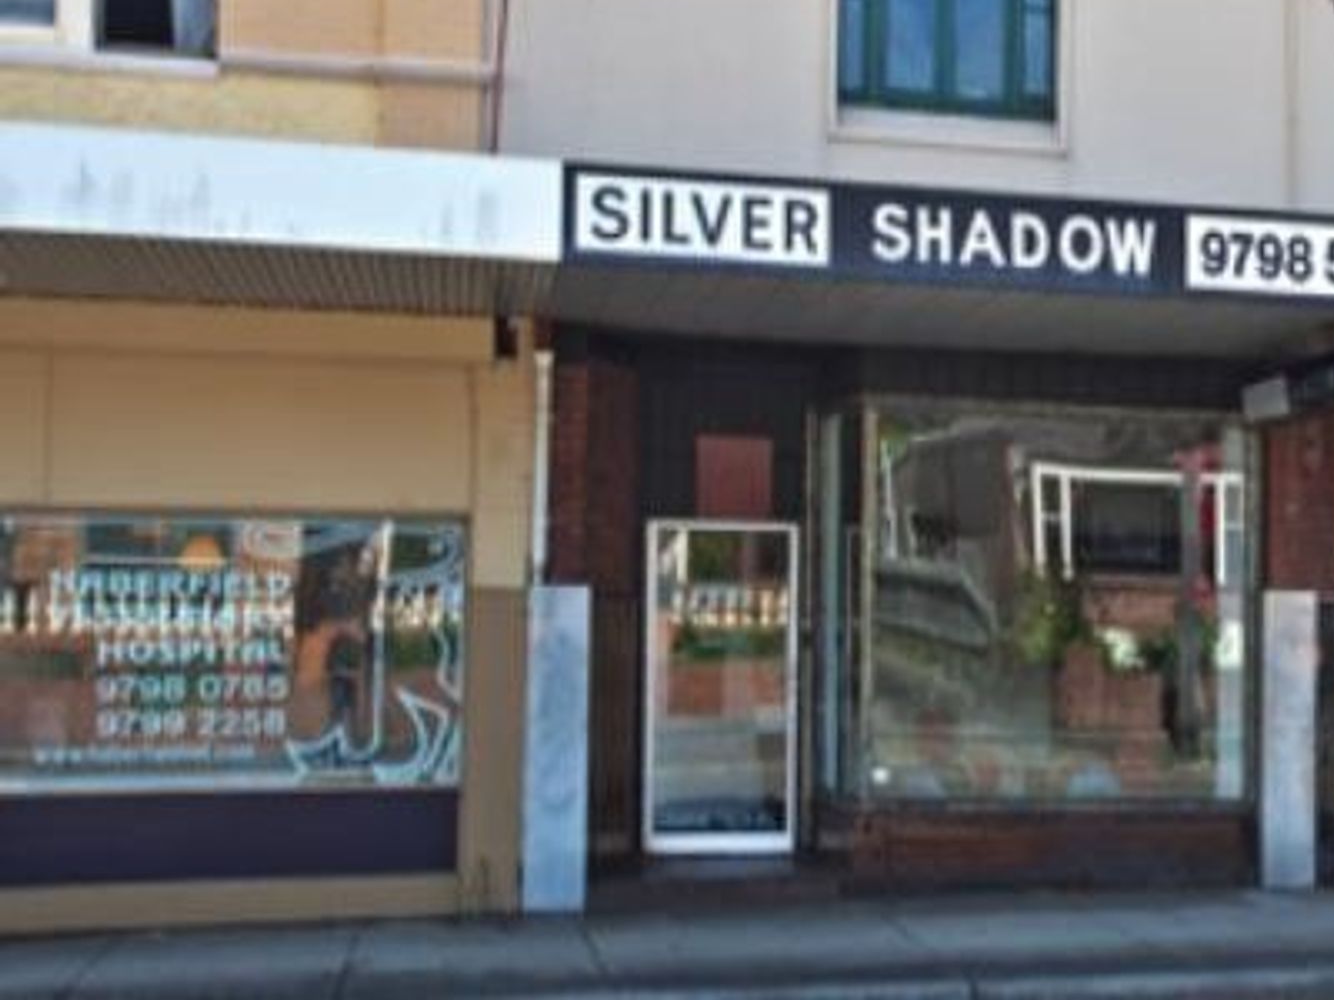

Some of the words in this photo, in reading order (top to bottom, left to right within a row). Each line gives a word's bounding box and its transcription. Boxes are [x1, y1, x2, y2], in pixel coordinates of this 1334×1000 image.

[590, 186, 820, 253] SILVER
[872, 202, 1156, 277] SHADOW
[1201, 229, 1314, 280] 9798
[98, 638, 285, 667] HOSPITAL
[97, 674, 187, 701] 9798
